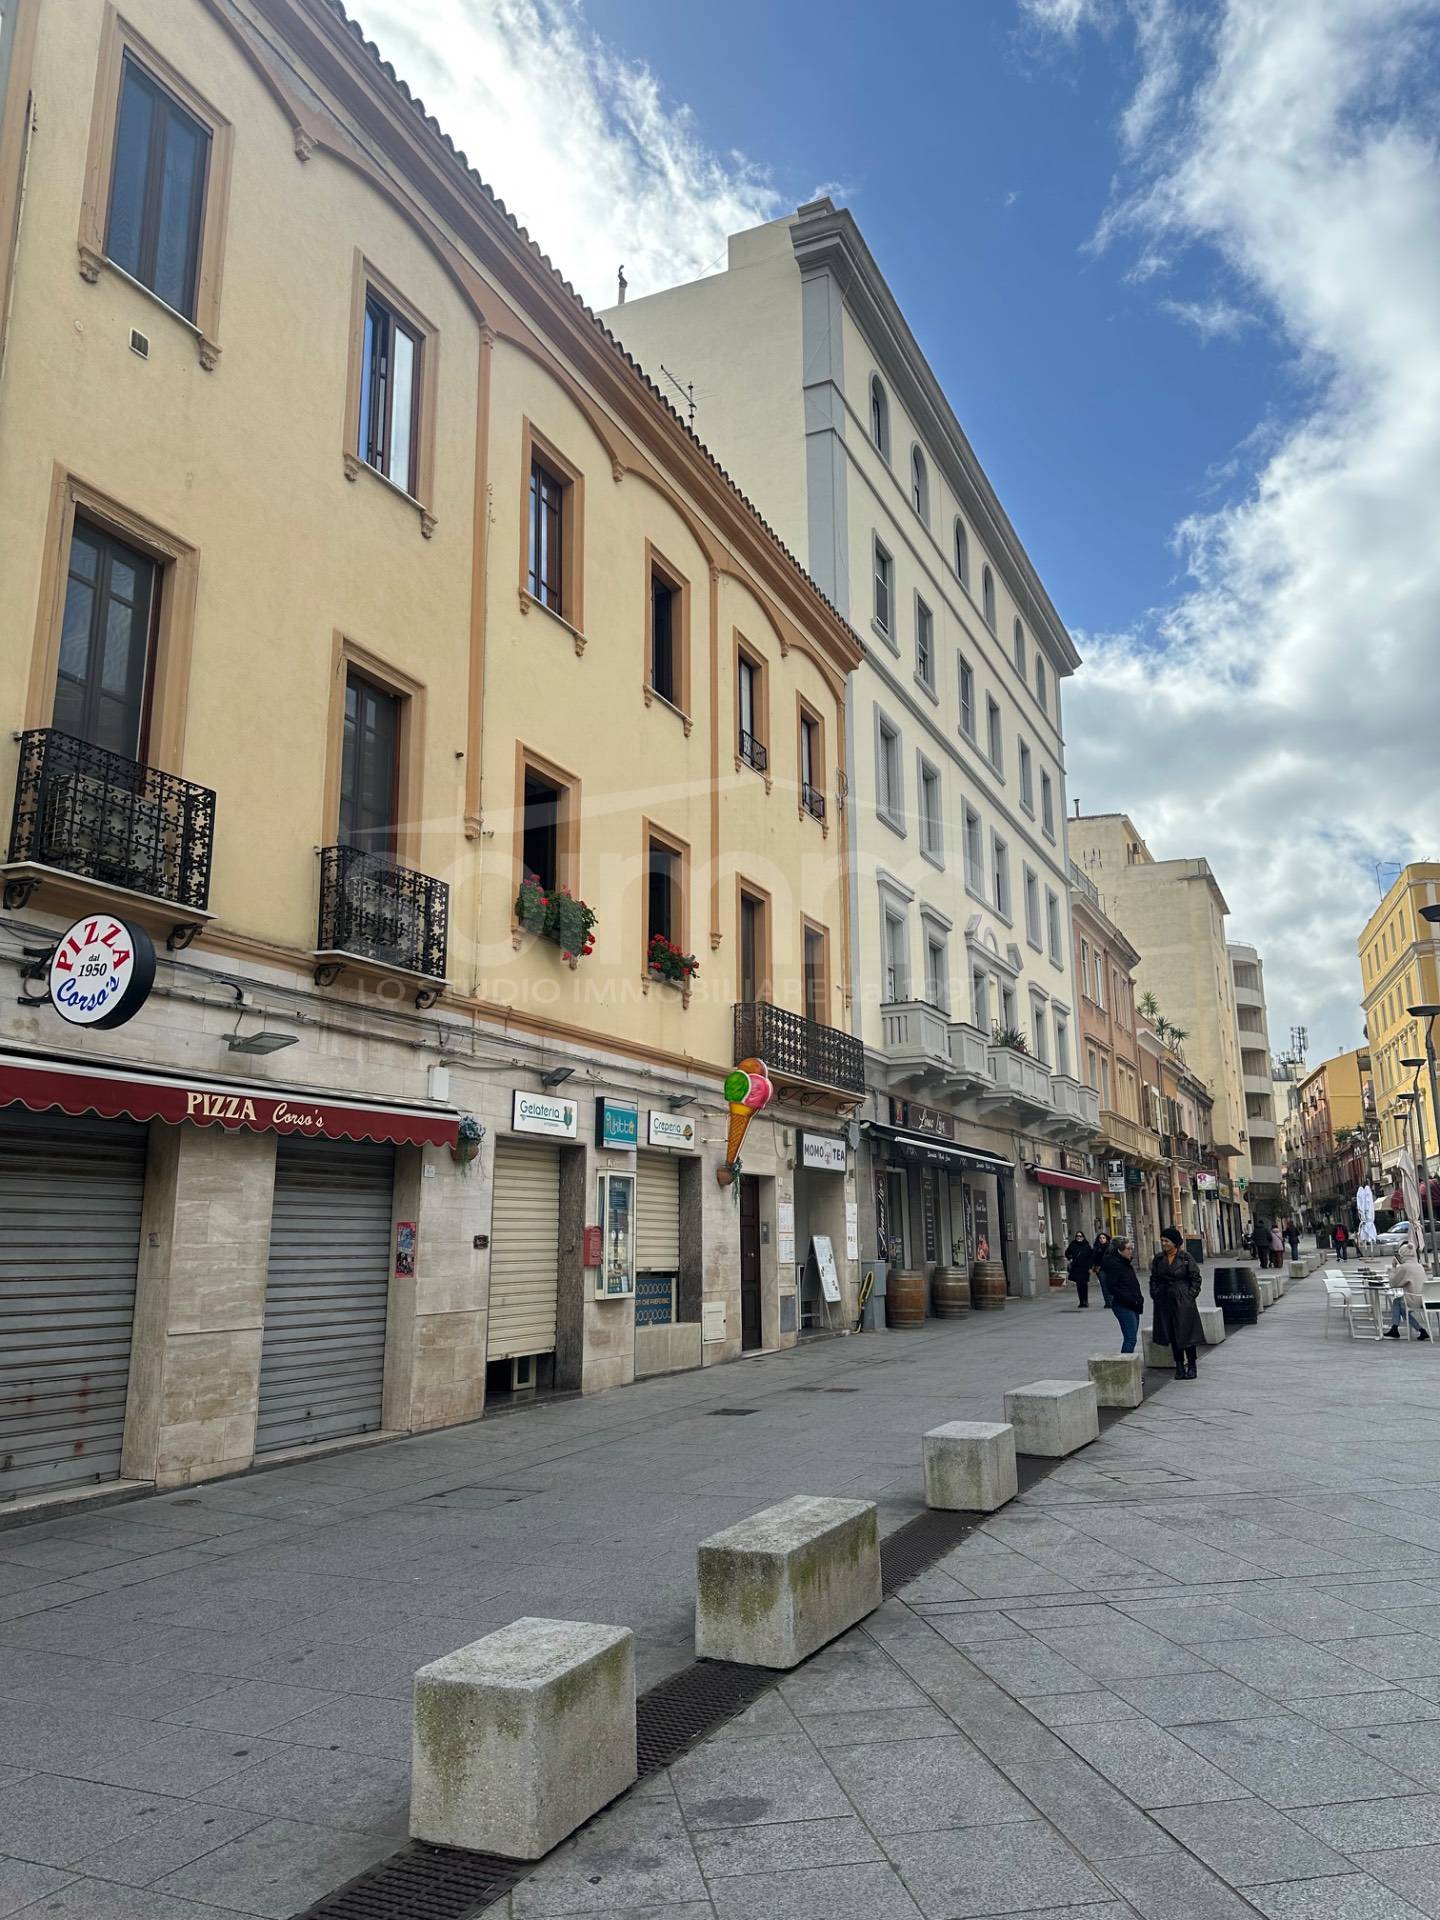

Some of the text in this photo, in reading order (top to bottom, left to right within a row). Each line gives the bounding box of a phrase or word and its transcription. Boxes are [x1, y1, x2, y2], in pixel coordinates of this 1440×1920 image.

[56, 921, 130, 972] PIZZA
[78, 963, 107, 977] 1950
[57, 976, 119, 1011] Corso's
[186, 1092, 325, 1127] PIZZA Corso's
[520, 1100, 560, 1119] Gelateria
[804, 1143, 845, 1161] MOMO TEA
